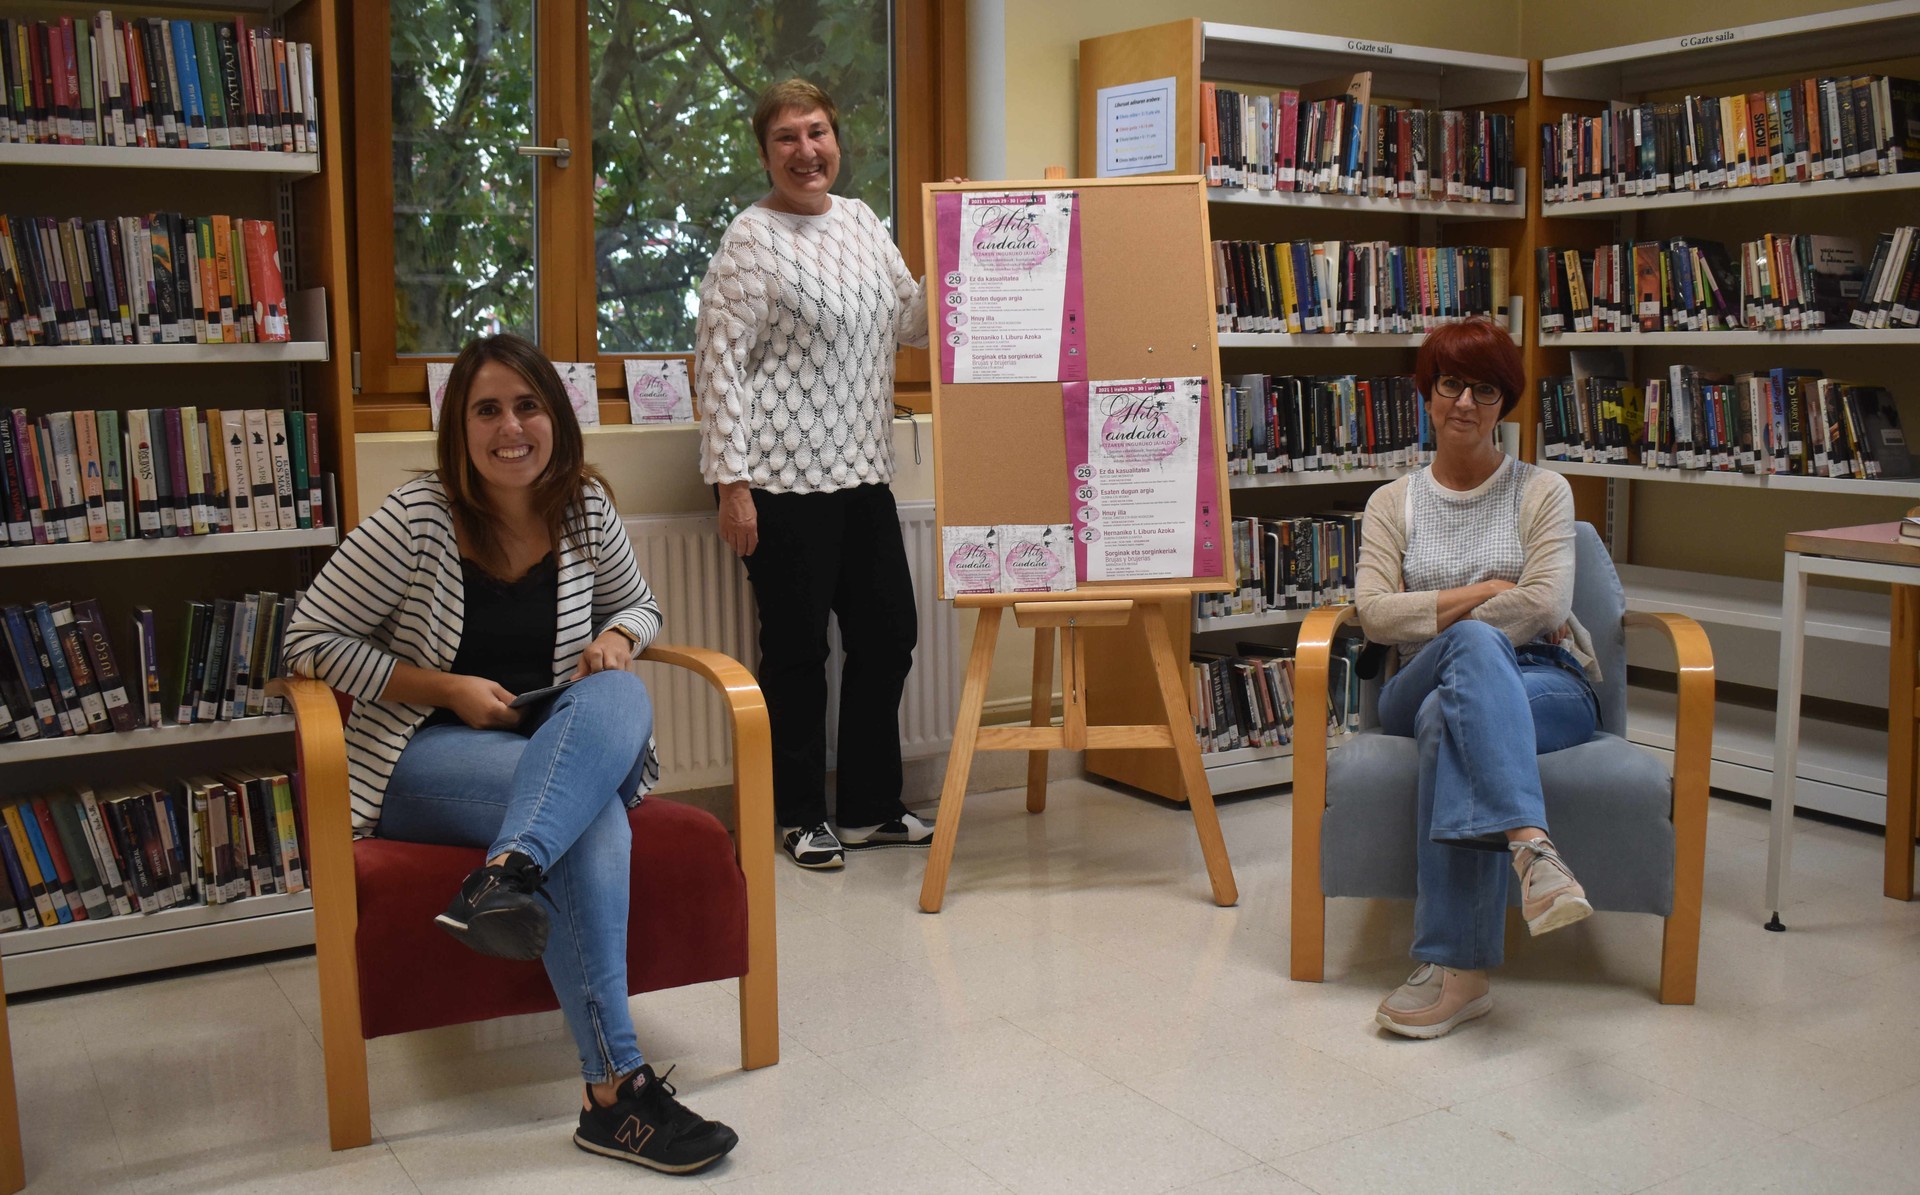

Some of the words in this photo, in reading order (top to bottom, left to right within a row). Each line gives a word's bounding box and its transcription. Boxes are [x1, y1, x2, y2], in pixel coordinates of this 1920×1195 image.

[1680, 38, 1688, 47] G
[1690, 36, 1714, 46] Gazte
[1715, 31, 1734, 41] saila
[1348, 40, 1354, 50] G
[1356, 42, 1376, 52] Gazte
[1377, 45, 1392, 54] saila
[1754, 114, 1766, 147] SHOW
[972, 205, 1039, 241] Hitz
[977, 236, 1039, 250] andana
[949, 275, 961, 284] 29
[949, 295, 962, 304] 30
[954, 336, 960, 344] 2
[1100, 393, 1168, 431] Hitz
[1106, 425, 1168, 441] andana
[3, 439, 12, 454] BLUE
[234, 446, 241, 456] EL
[256, 451, 264, 462] LA
[235, 458, 244, 484] GRAN
[275, 456, 283, 474] LOS
[1078, 469, 1091, 478] 29
[1080, 490, 1092, 499] 30
[1084, 511, 1089, 519] 1
[1085, 532, 1092, 540] 2
[956, 559, 992, 568] andana
[1013, 558, 1048, 567] andana
[614, 1114, 655, 1153] N
